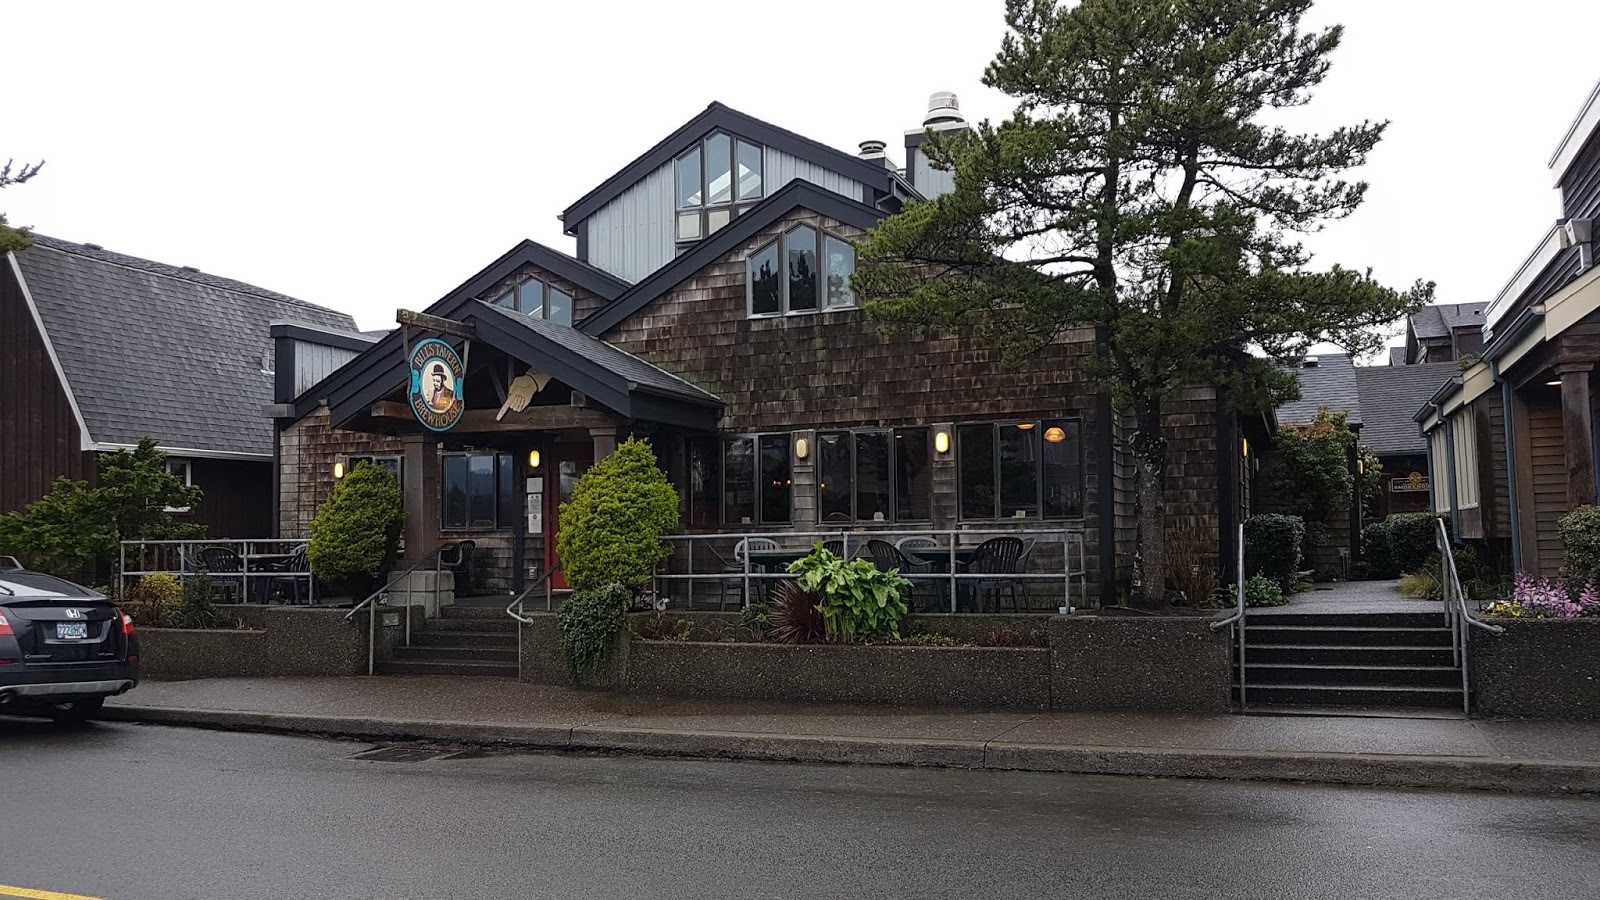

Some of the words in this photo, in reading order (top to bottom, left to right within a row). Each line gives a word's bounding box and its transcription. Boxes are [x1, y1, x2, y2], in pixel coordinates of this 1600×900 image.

[415, 343, 435, 367] BILL'S
[435, 344, 462, 373] TAVERN
[415, 398, 461, 426] BREWHOUSE
